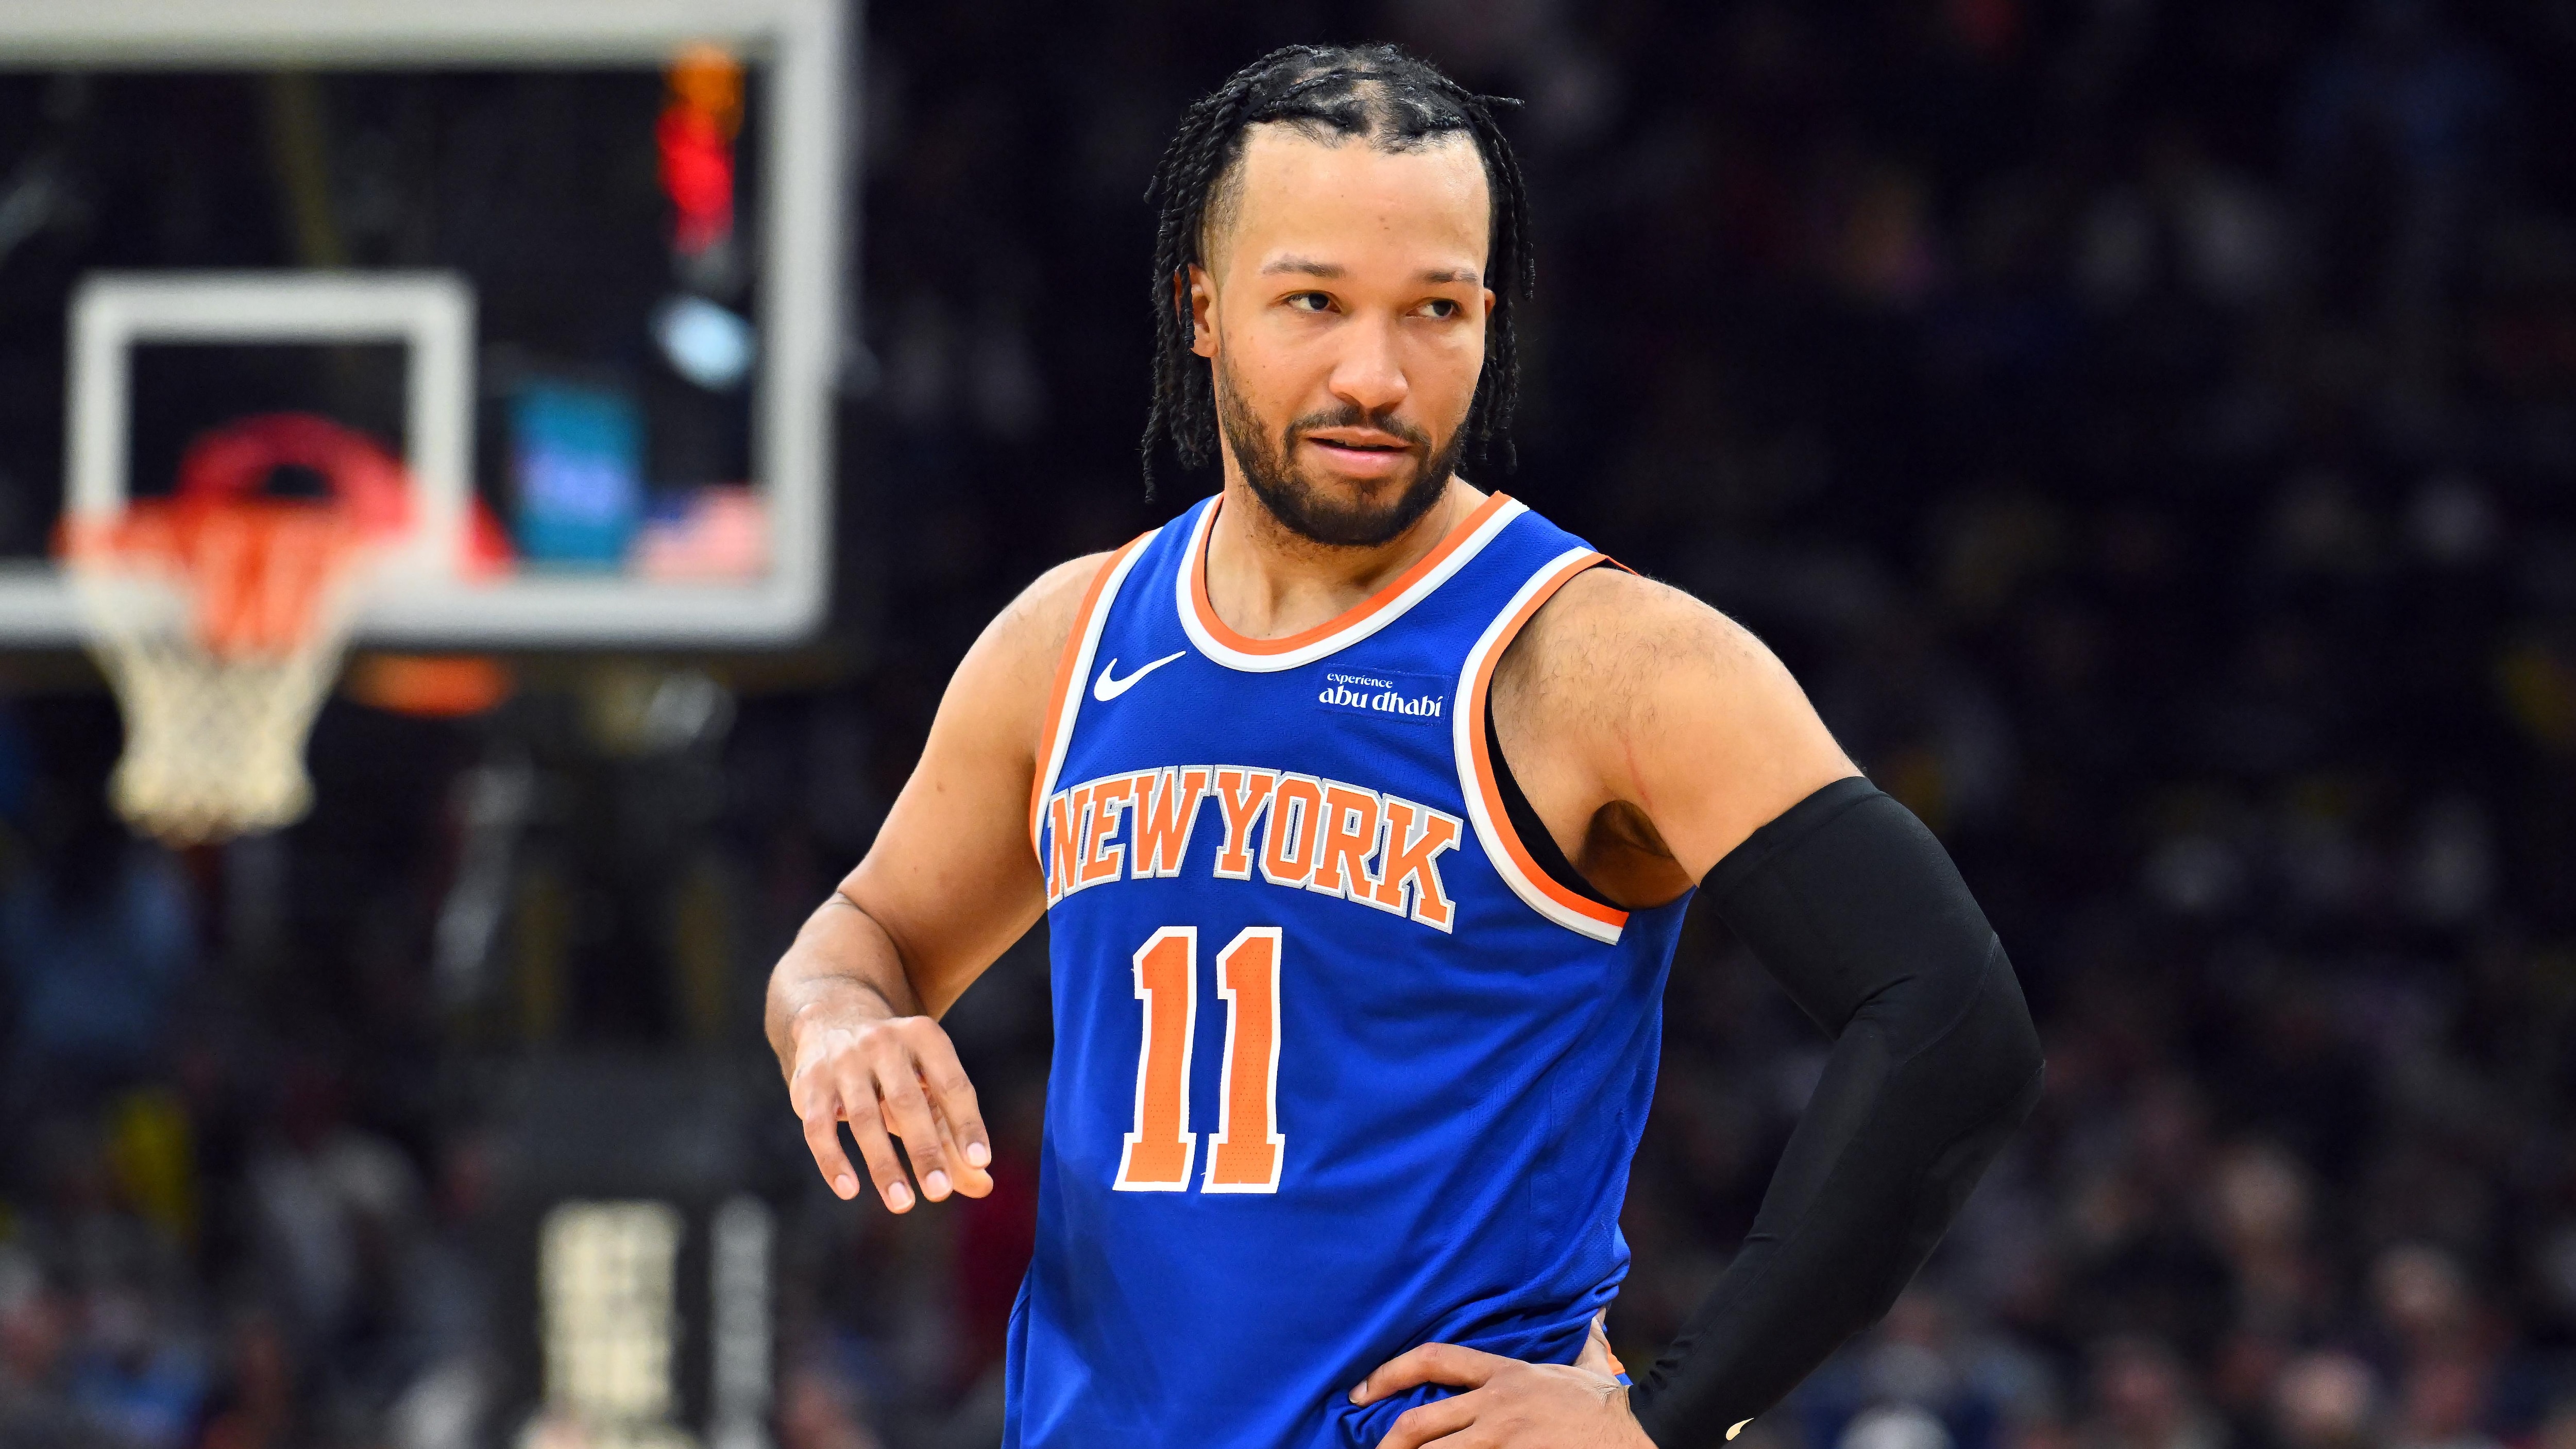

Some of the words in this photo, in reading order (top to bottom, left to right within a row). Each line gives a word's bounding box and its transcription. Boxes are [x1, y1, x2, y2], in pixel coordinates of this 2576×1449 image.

[1319, 685, 1368, 708] abu
[1372, 691, 1443, 717] dhabi
[1327, 673, 1393, 688] experience
[1046, 765, 1212, 910] NEW
[1212, 764, 1463, 933] YORK
[1113, 926, 1285, 1194] 11
